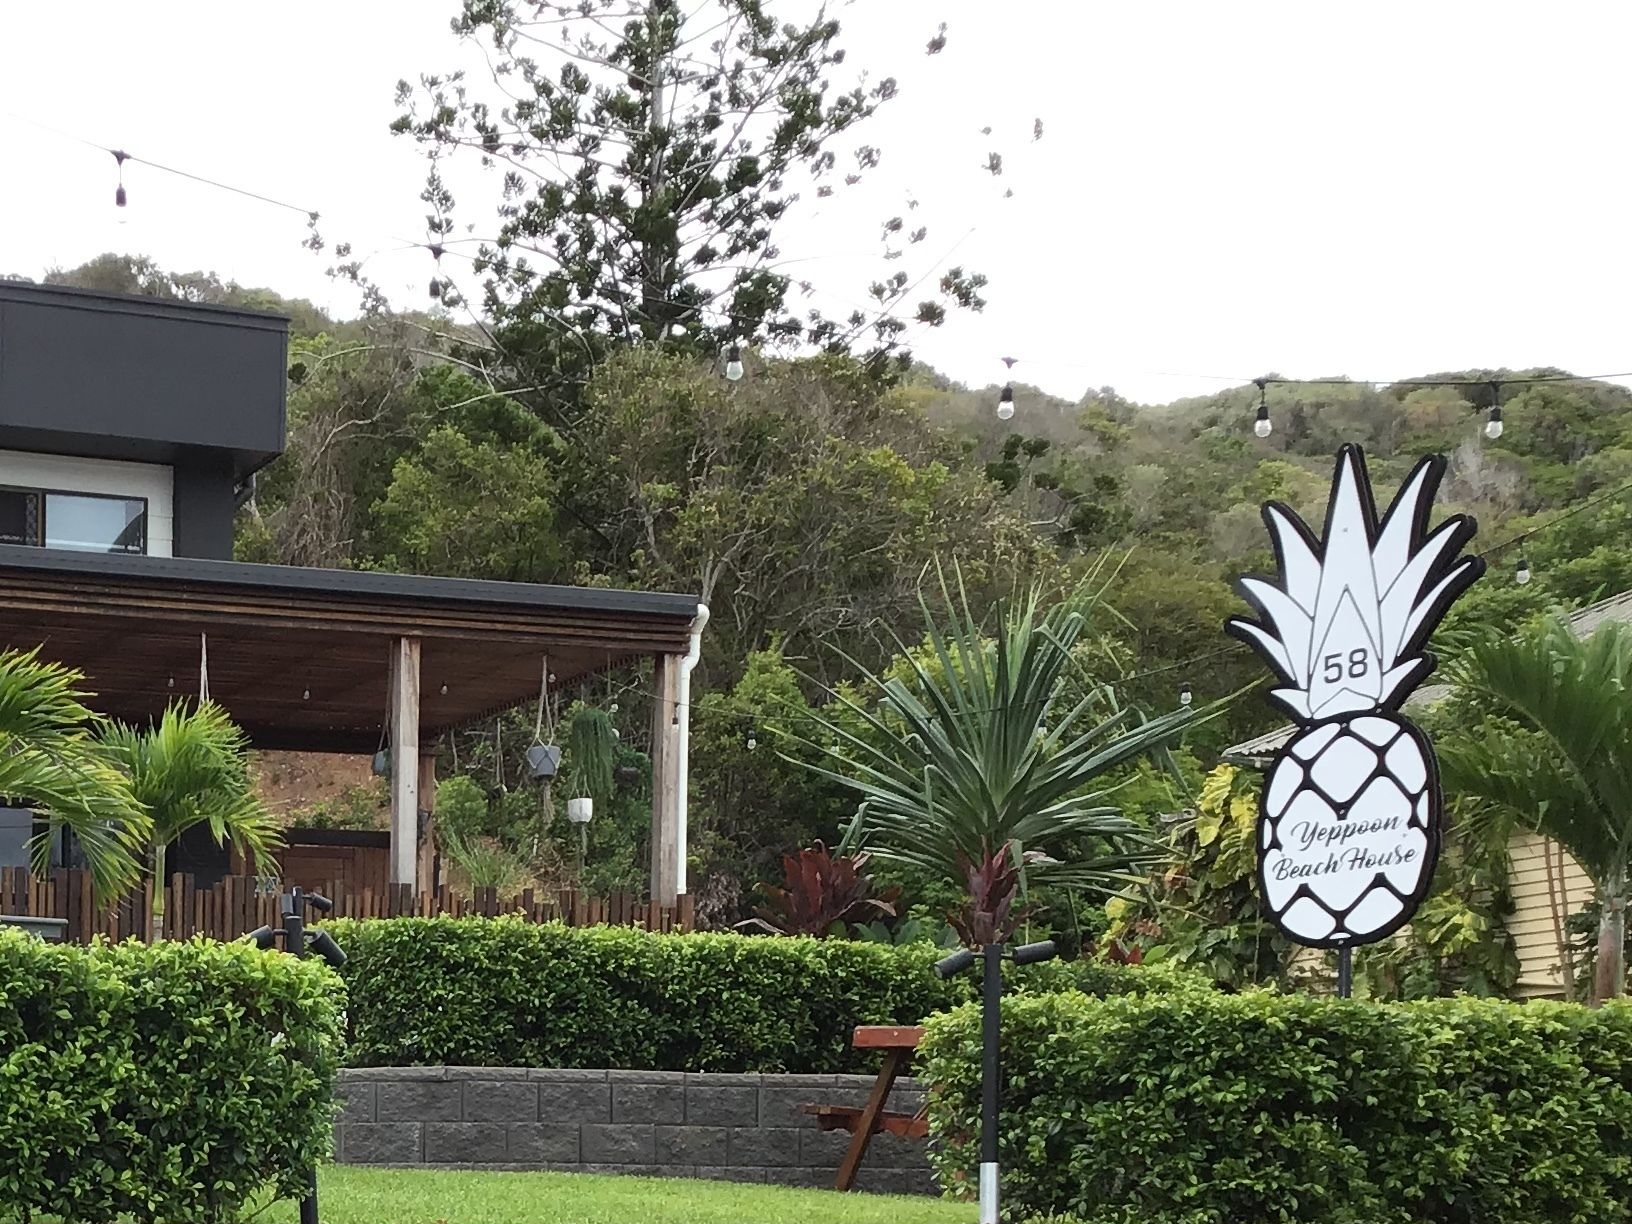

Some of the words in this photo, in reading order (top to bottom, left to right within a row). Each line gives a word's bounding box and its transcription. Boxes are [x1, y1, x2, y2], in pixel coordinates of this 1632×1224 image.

[1323, 647, 1369, 684] 58
[1290, 815, 1401, 852] Yeppoon
[1272, 852, 1339, 881] Beach
[1340, 844, 1418, 871] House
